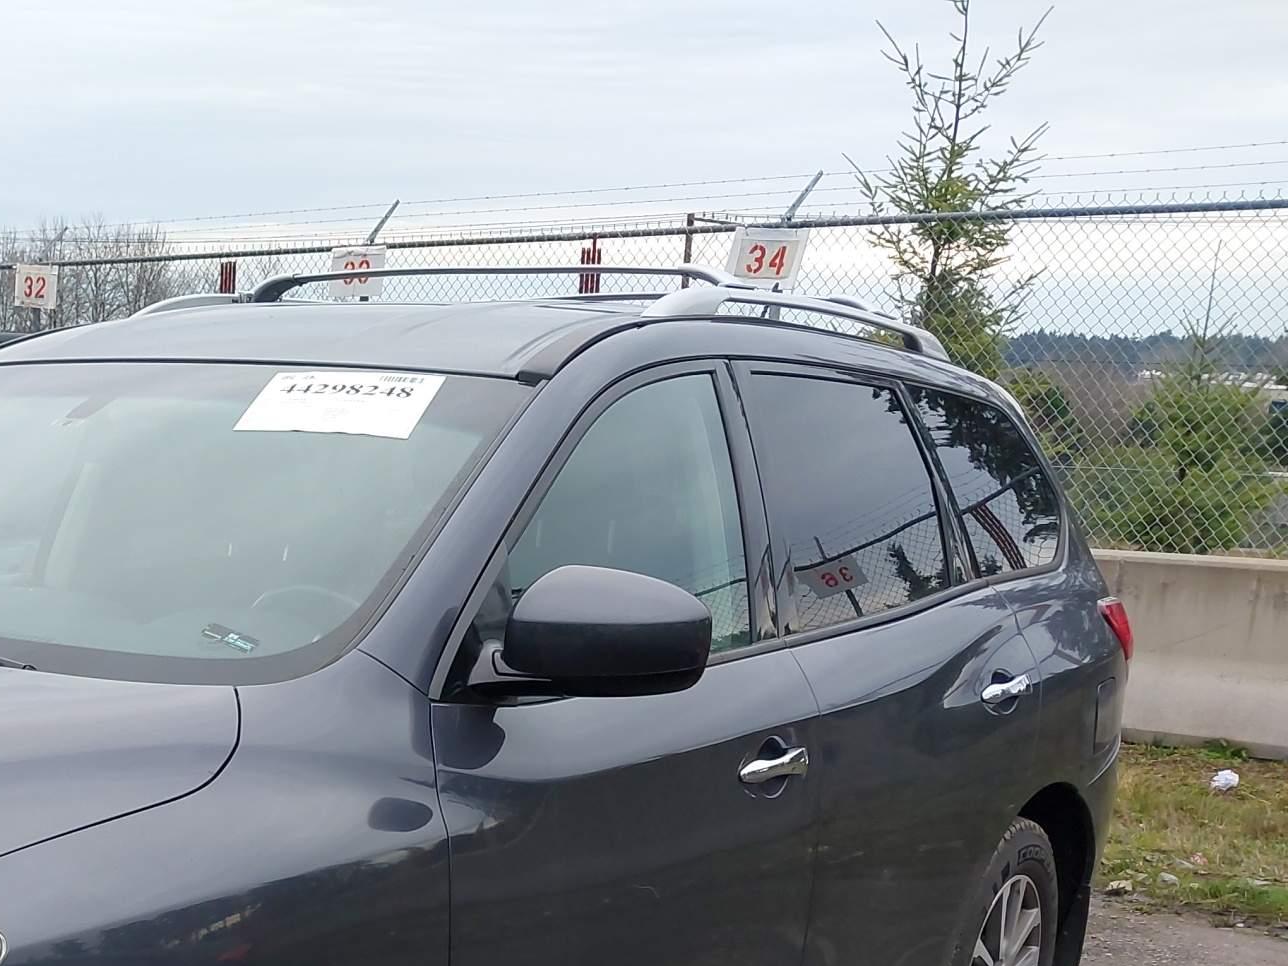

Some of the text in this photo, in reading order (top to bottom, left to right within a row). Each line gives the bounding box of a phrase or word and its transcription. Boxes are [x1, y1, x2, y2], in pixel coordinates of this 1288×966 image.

[746, 244, 787, 276] 34
[23, 275, 46, 299] 32
[279, 383, 414, 399] 44298248
